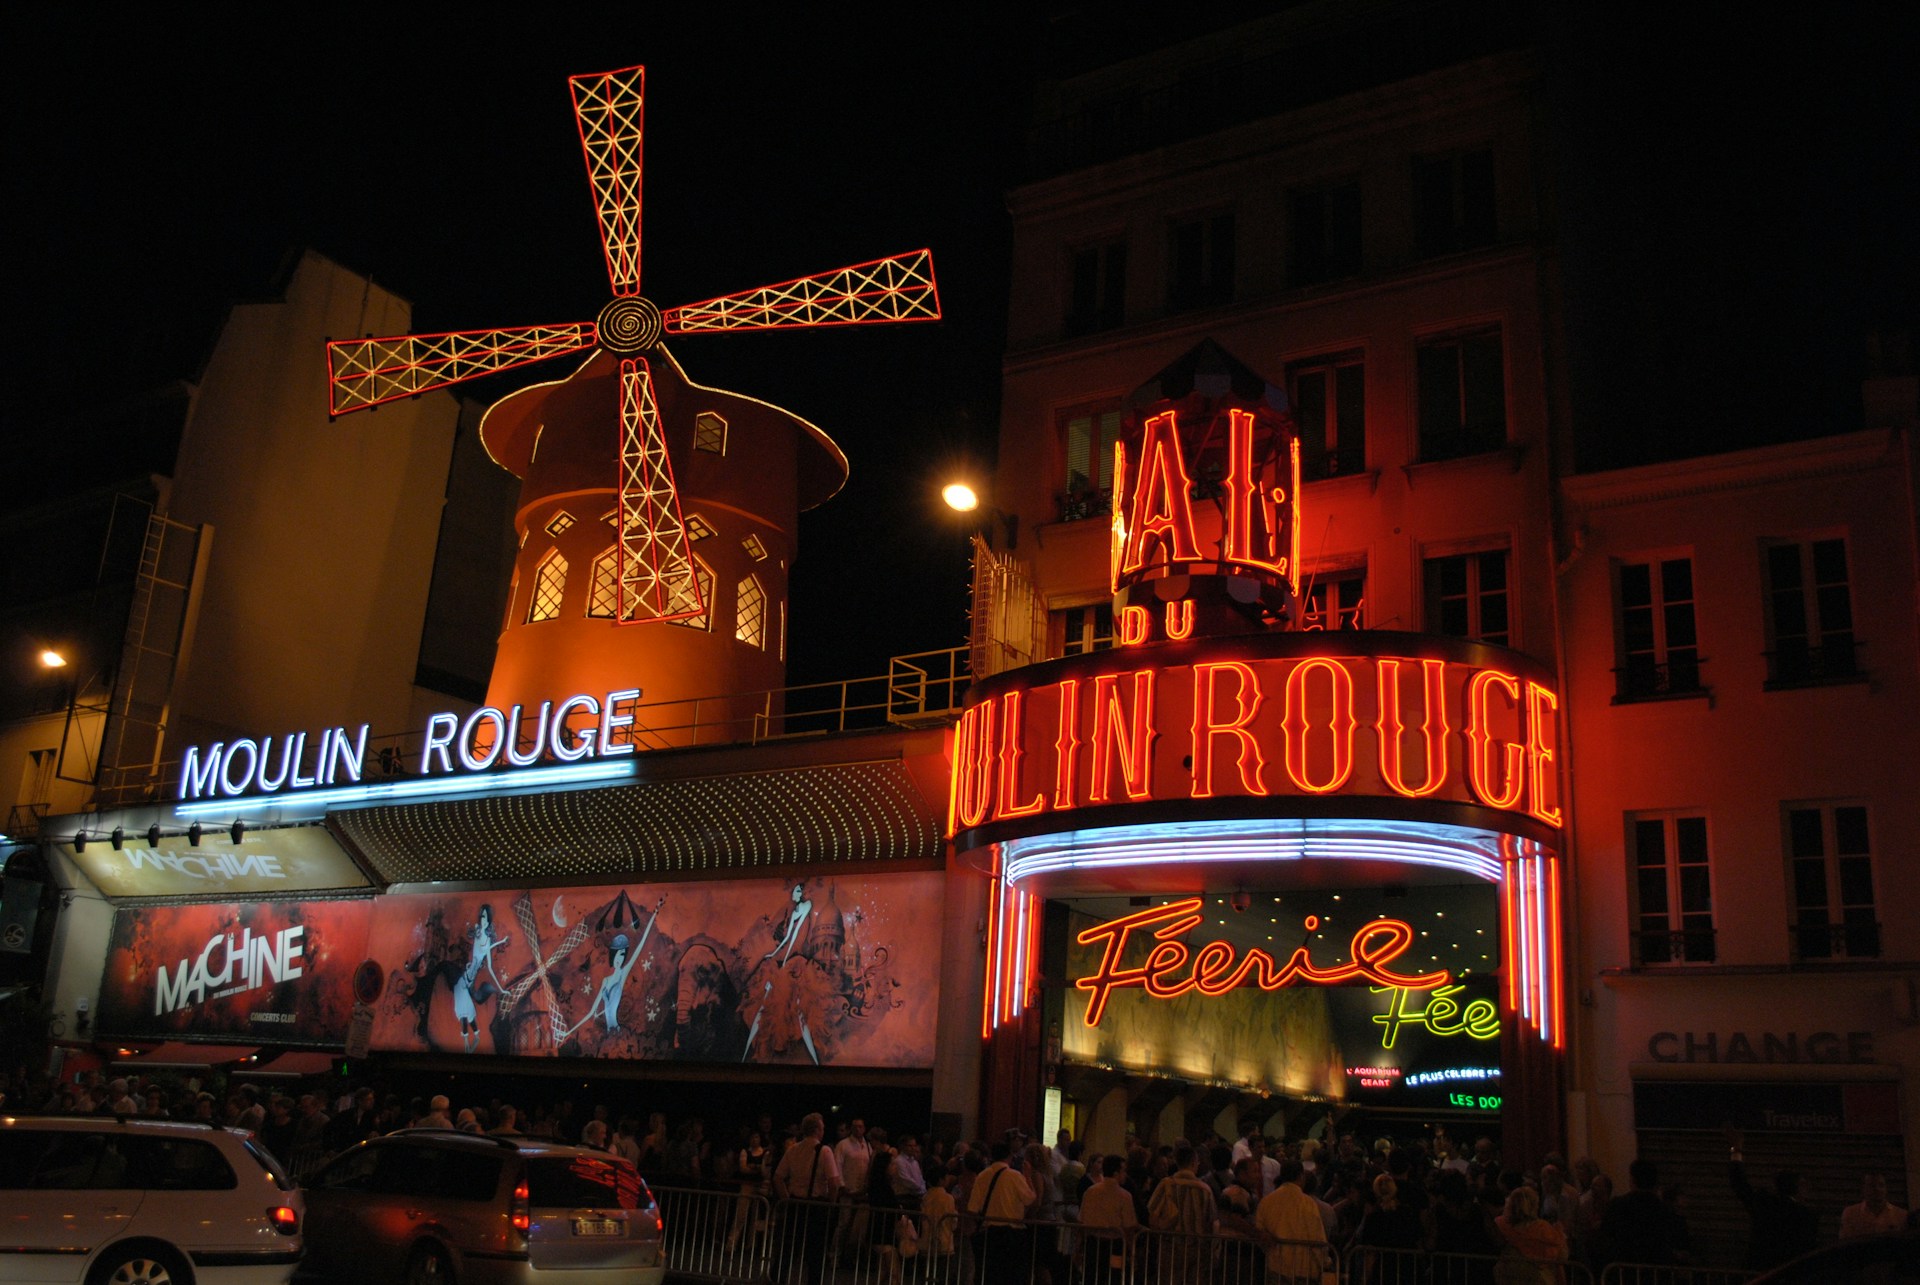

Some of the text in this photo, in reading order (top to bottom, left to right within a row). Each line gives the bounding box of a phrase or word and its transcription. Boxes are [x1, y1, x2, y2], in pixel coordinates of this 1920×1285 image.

[1120, 599, 1194, 645] DU
[178, 688, 641, 799] MOULIN ROUGE
[1190, 656, 1562, 828] ROUGE
[155, 925, 304, 1017] MACHINE
[1075, 896, 1451, 1028] Féerie
[1648, 1031, 1876, 1064] CHANGE
[1406, 1075, 1417, 1086] LE
[1419, 1072, 1444, 1083] PLUS
[1450, 1093, 1475, 1107] LES
[1762, 1108, 1840, 1129] Travelex
